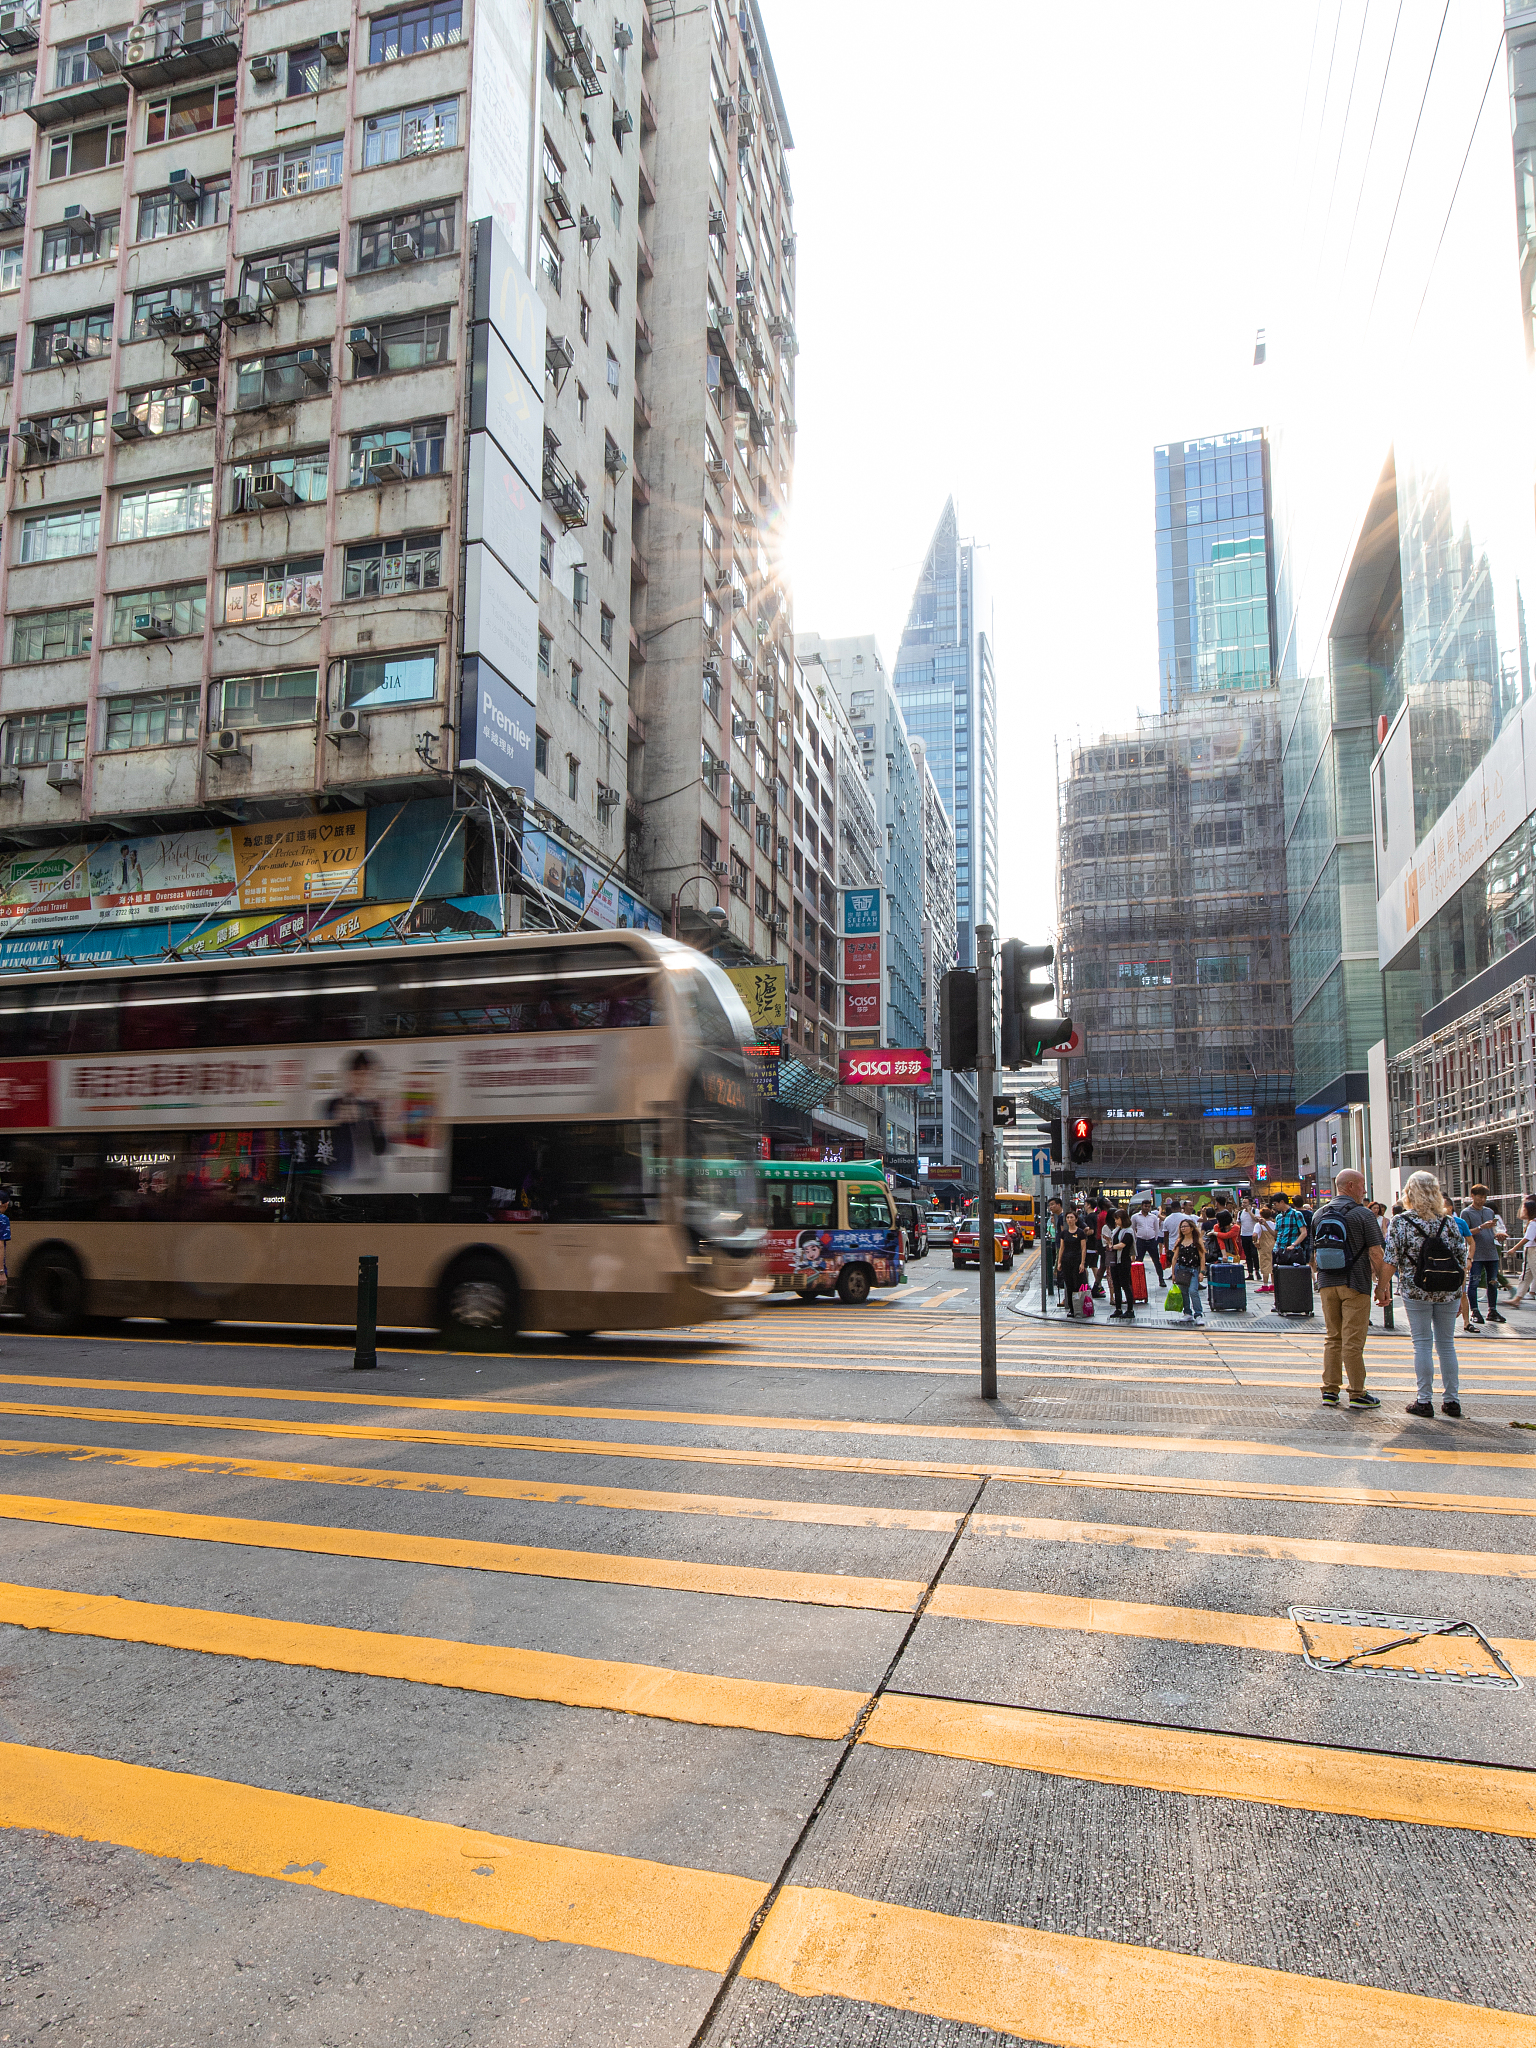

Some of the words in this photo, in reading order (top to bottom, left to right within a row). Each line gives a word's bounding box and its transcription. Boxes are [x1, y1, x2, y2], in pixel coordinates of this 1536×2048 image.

[384, 581, 400, 591] 4/F
[267, 603, 283, 617] 4/F
[483, 691, 531, 751] Premier
[483, 725, 514, 758] 卓越理財
[333, 824, 356, 837] 旅程
[1458, 834, 1484, 869] Shopping
[1484, 809, 1506, 842] Centre
[275, 848, 298, 858] Perfect
[301, 845, 316, 856] Trip
[322, 846, 359, 864] YOU
[247, 861, 290, 872] Tilor-made
[305, 858, 319, 866] For
[39, 873, 75, 894] travel
[164, 872, 205, 882] SUNFLOWER
[156, 889, 184, 901] Overseas
[186, 887, 213, 898] Wedding
[283, 894, 301, 902] Booking
[16, 904, 49, 914] Eductional
[51, 902, 69, 911] Travel
[847, 916, 878, 924] SEEFAH
[6, 940, 50, 954] WELCOME
[52, 939, 65, 950] TO
[79, 951, 113, 962] WORLD
[761, 1070, 777, 1078] VISA
[894, 1060, 922, 1075] 莎莎
[715, 1168, 724, 1176] 19
